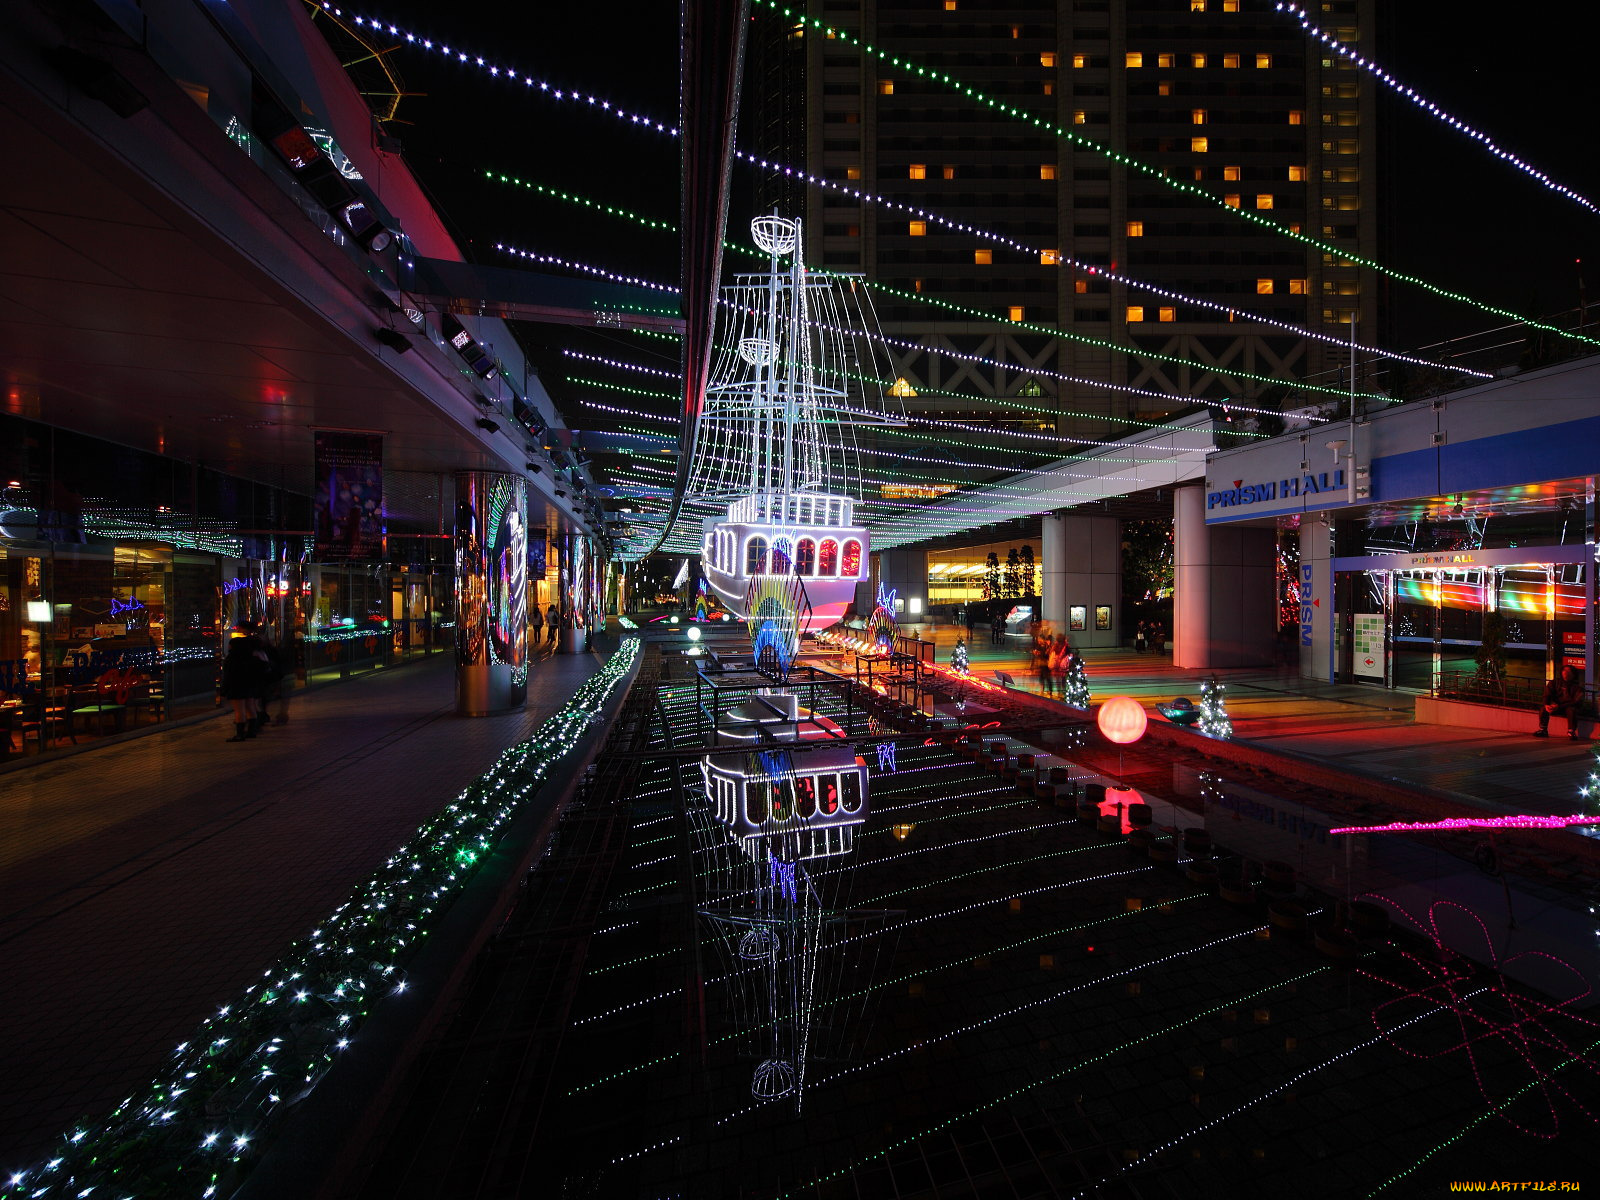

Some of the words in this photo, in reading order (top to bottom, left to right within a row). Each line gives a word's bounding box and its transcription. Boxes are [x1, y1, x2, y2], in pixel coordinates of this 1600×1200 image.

[1207, 480, 1276, 510] PRISM
[1279, 470, 1349, 499] HALL
[1412, 553, 1444, 564] PRISM
[1446, 554, 1475, 563] HALL
[1302, 564, 1313, 647] PRISM
